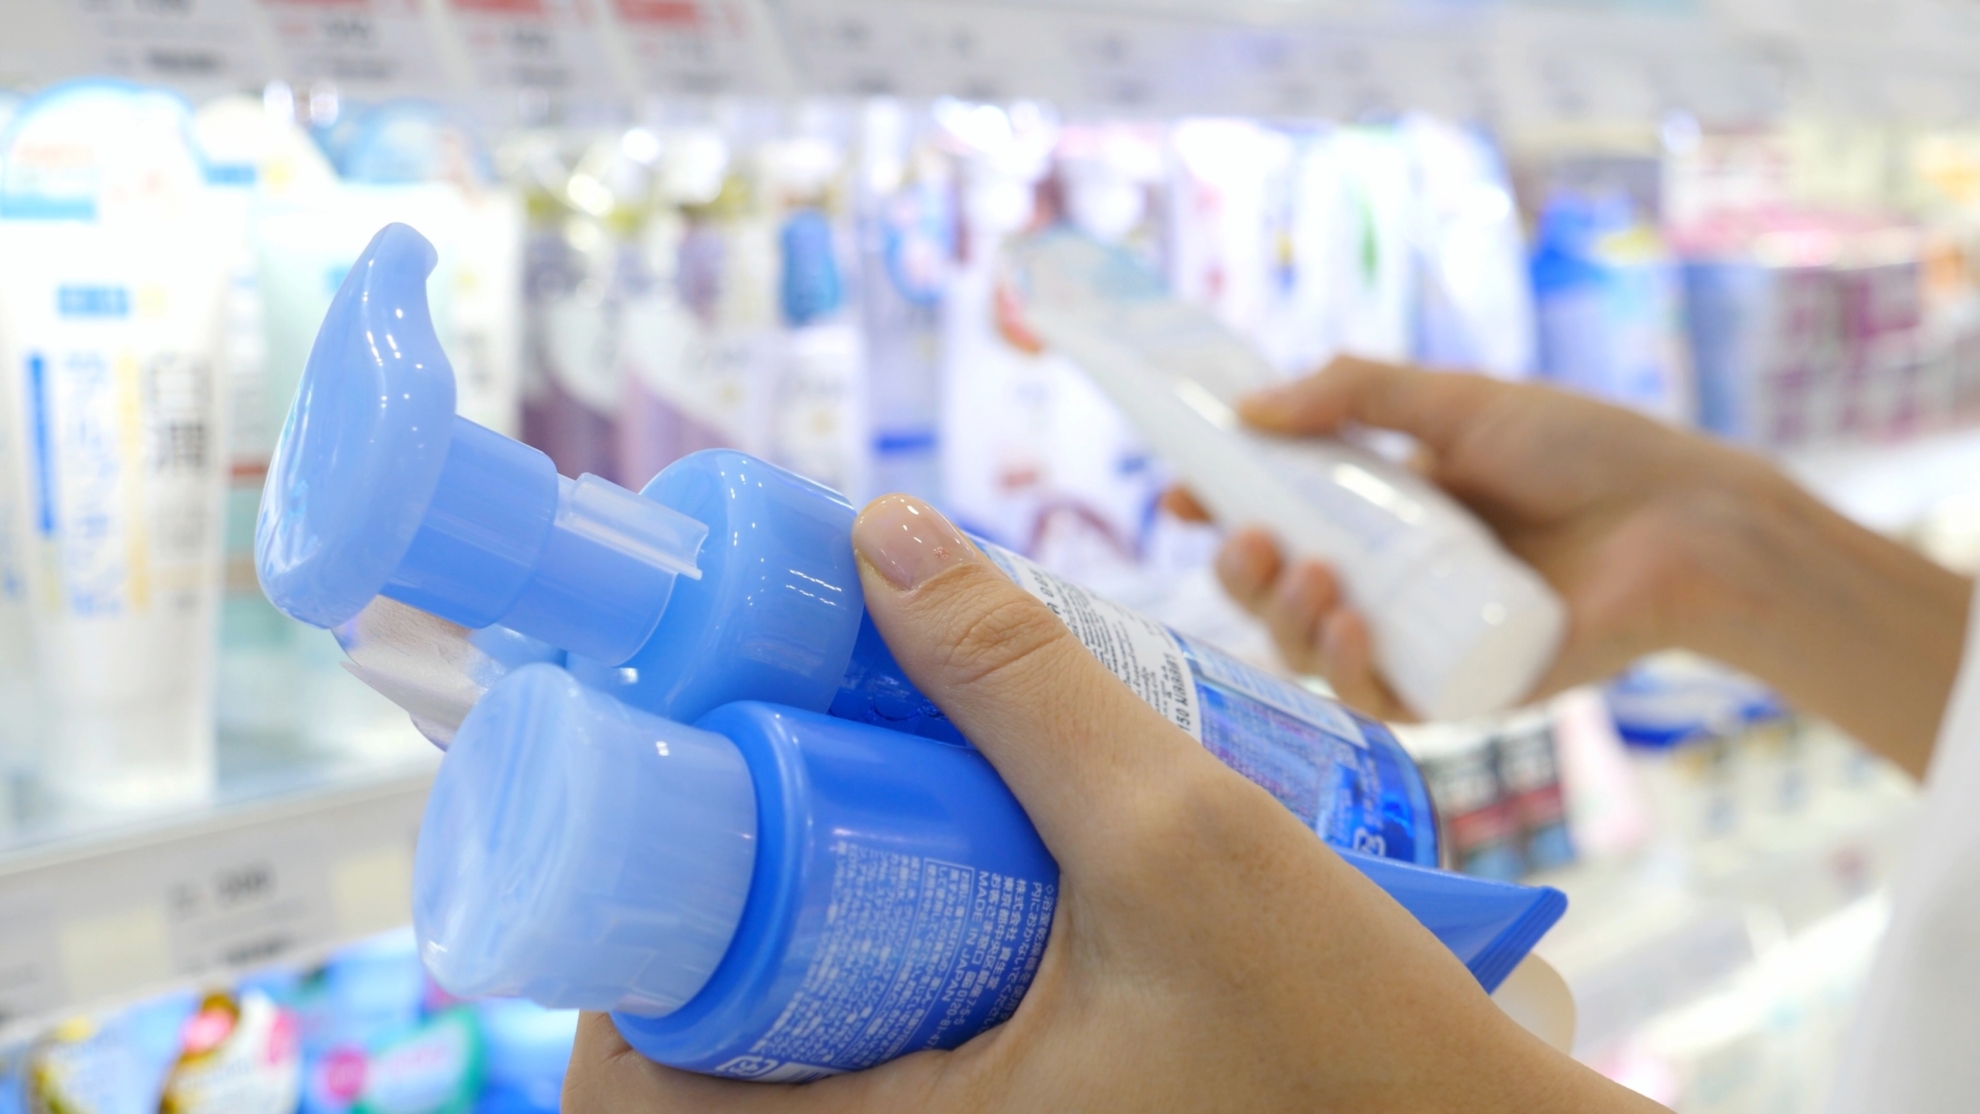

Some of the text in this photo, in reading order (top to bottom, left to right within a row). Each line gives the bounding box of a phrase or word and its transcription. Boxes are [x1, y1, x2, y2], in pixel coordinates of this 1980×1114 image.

[941, 870, 988, 1002] MADE IN JAPAN
